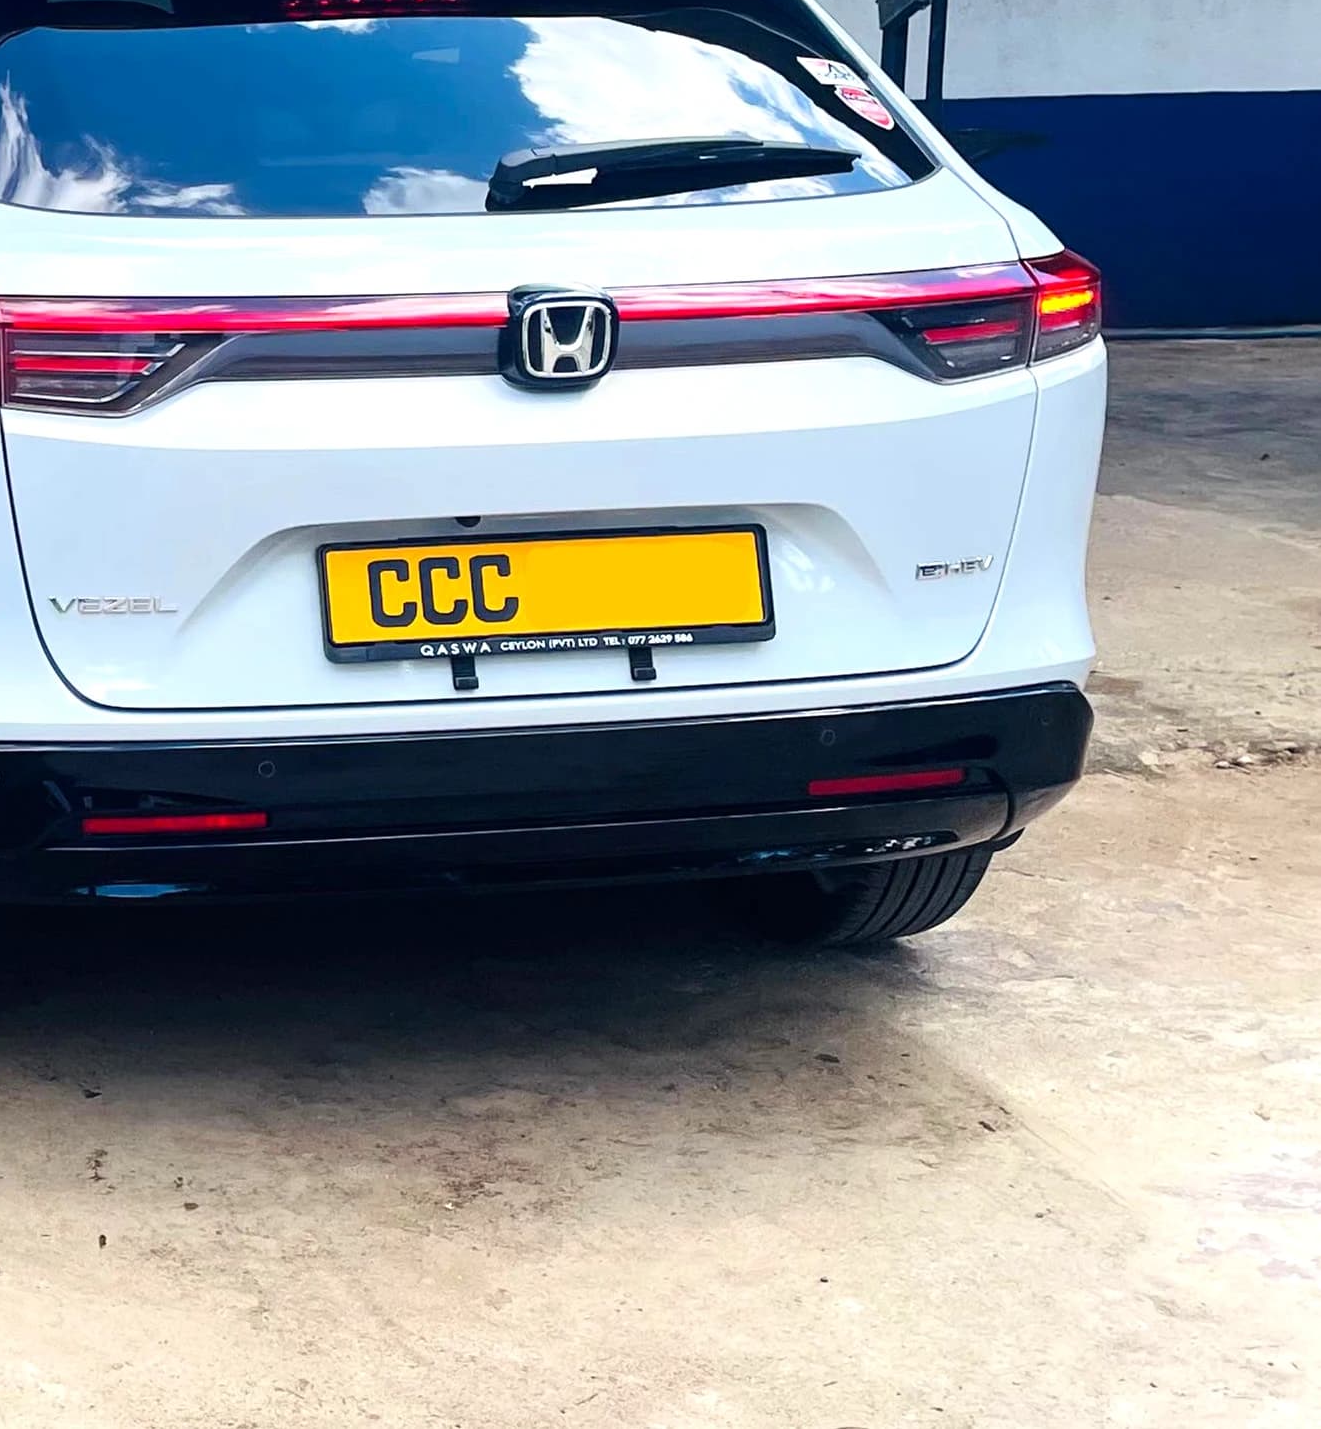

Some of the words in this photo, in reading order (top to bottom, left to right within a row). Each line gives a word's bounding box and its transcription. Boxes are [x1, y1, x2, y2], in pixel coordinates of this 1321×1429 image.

[367, 553, 520, 628] CCC
[48, 596, 179, 614] VEZEL
[420, 642, 492, 657] QASWA
[500, 639, 547, 652] CEYLON
[548, 637, 576, 650] (PVT)
[578, 636, 598, 648] LTD
[628, 633, 646, 646] 077
